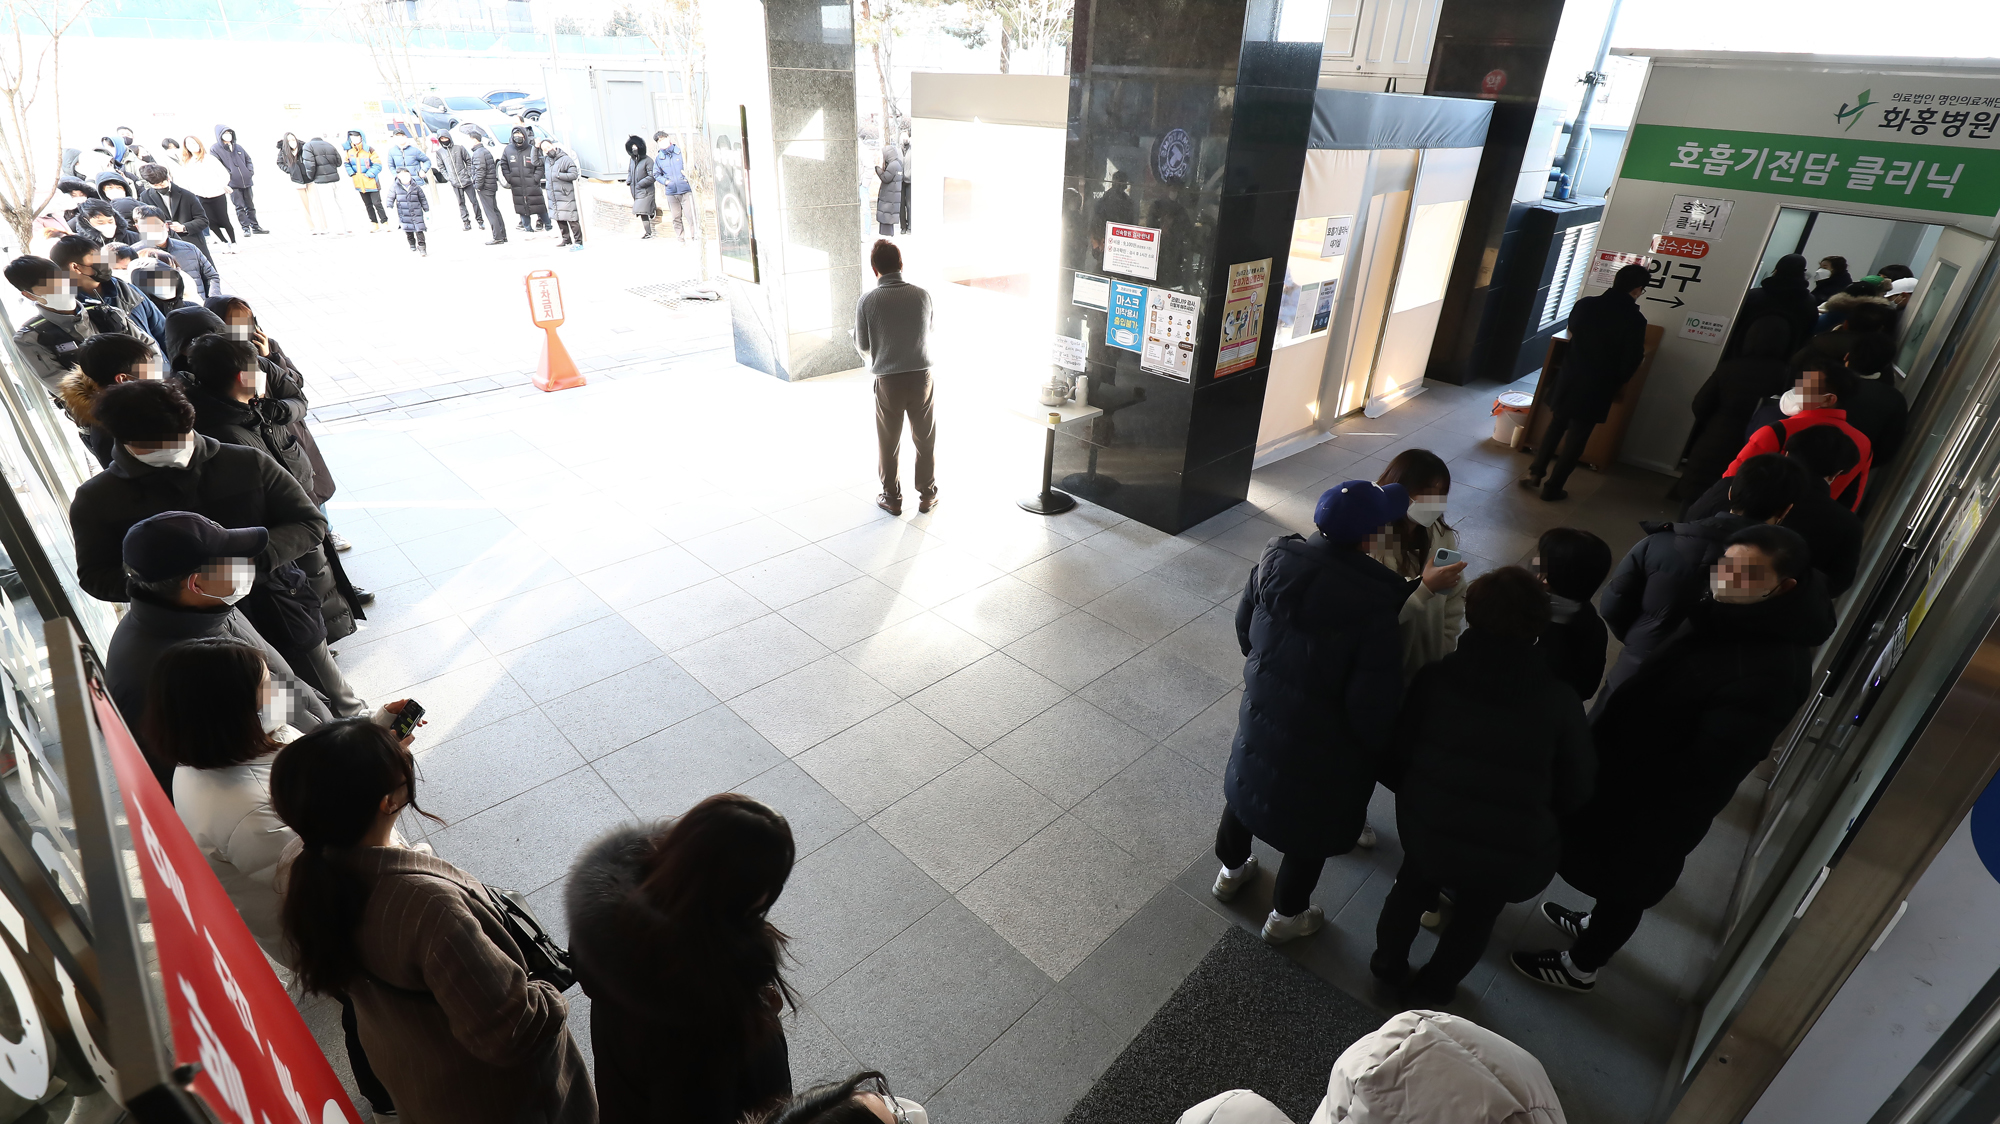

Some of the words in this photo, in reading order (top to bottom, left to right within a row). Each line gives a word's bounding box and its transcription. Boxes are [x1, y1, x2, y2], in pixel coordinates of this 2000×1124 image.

[1891, 93, 1936, 105] 의료법인
[1878, 107, 2000, 139] 화홍병원
[1669, 141, 1840, 186] 호흡기전담
[1846, 155, 1965, 198] 클리닉
[1676, 216, 1715, 232] 클리닉
[1648, 259, 1702, 293] 입구
[539, 280, 554, 319] 주차금지
[1116, 294, 1140, 309] 마스크
[1115, 306, 1139, 319] 미착용시
[1113, 316, 1139, 330] 출입불가
